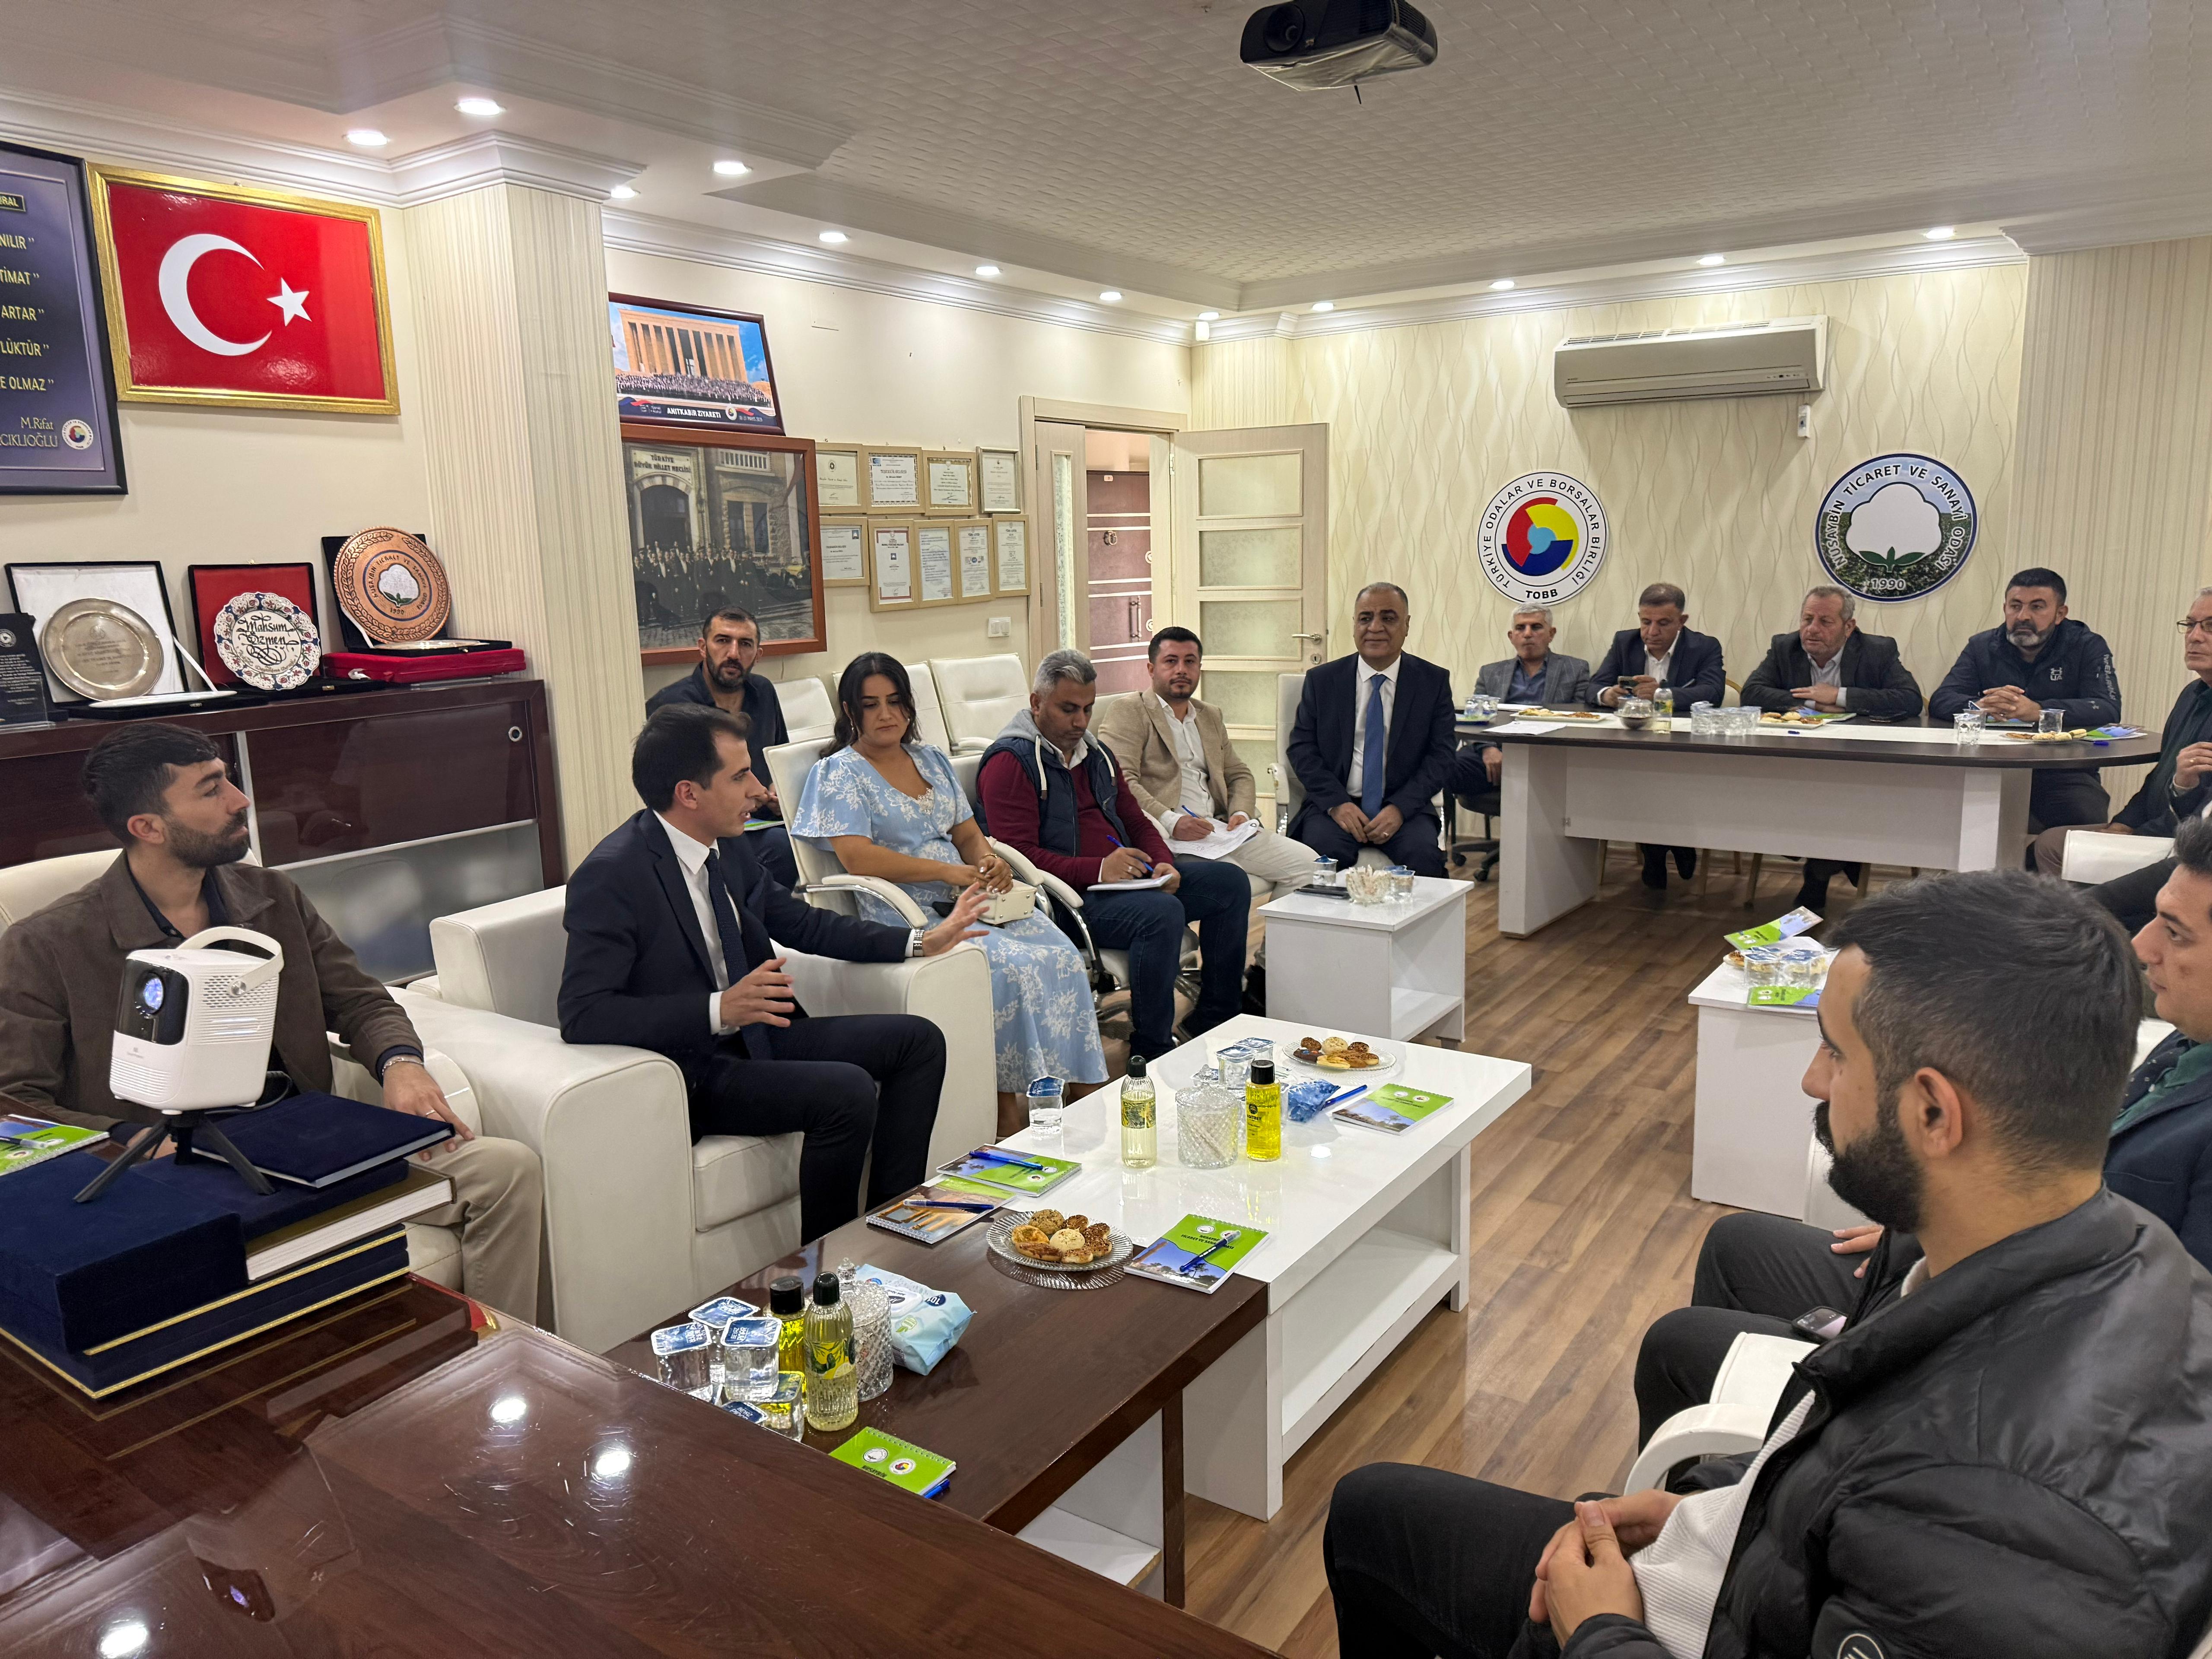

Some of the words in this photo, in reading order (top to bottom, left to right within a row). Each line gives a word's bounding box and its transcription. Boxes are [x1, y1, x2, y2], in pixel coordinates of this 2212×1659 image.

[1, 305, 37, 321] ARTAR
[0, 338, 41, 356] LÜKTÜR
[9, 377, 46, 391] OLMAZ
[21, 417, 54, 430] M.Rifat
[0, 432, 58, 447] CIKLIOĞLU
[1527, 479, 1543, 489] VE
[1843, 465, 1901, 496] TİCARET
[1910, 466, 1927, 479] VE
[1932, 476, 1967, 521] SANAYİ
[1486, 486, 1522, 529] ODALAR
[1550, 479, 1599, 530] BORSALAR
[1483, 536, 1510, 588] TÜRKİYE
[1872, 579, 1905, 590] 1990
[1526, 589, 1557, 599] TOBB
[240, 617, 290, 632] Mahsum
